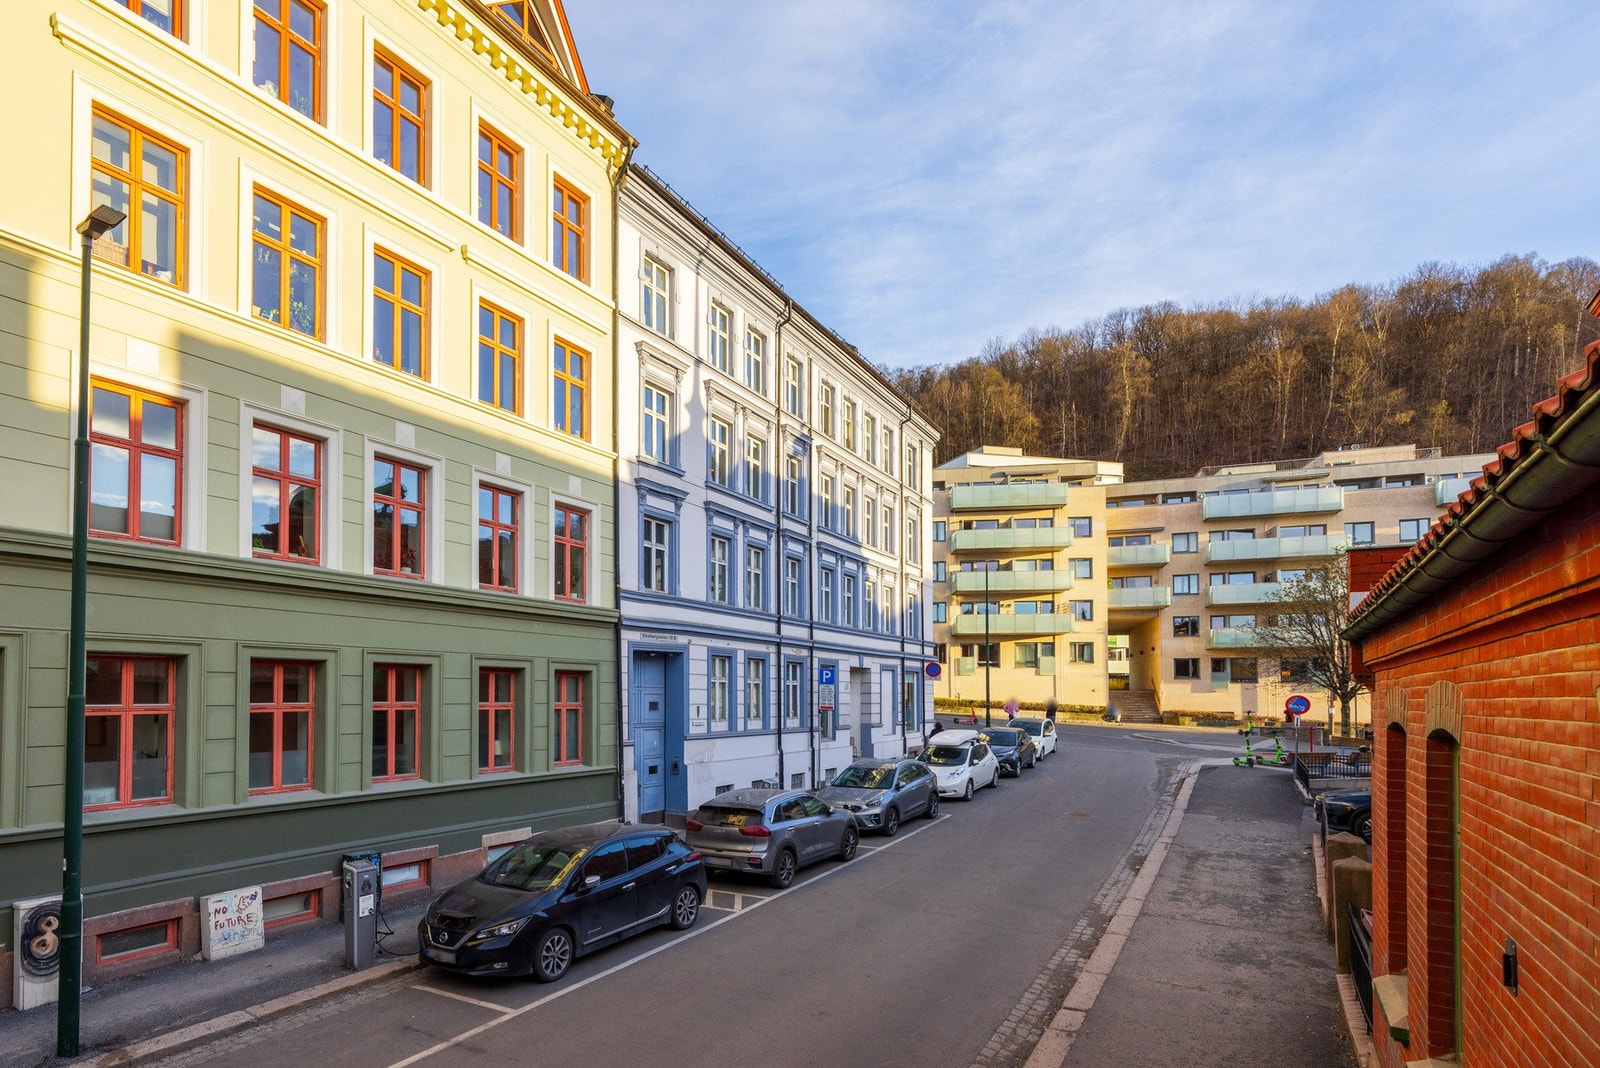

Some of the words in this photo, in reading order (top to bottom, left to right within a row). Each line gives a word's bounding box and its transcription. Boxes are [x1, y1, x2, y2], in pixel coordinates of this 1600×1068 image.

[823, 670, 831, 682] P
[214, 906, 227, 919] NO
[214, 913, 253, 930] FUTURE
